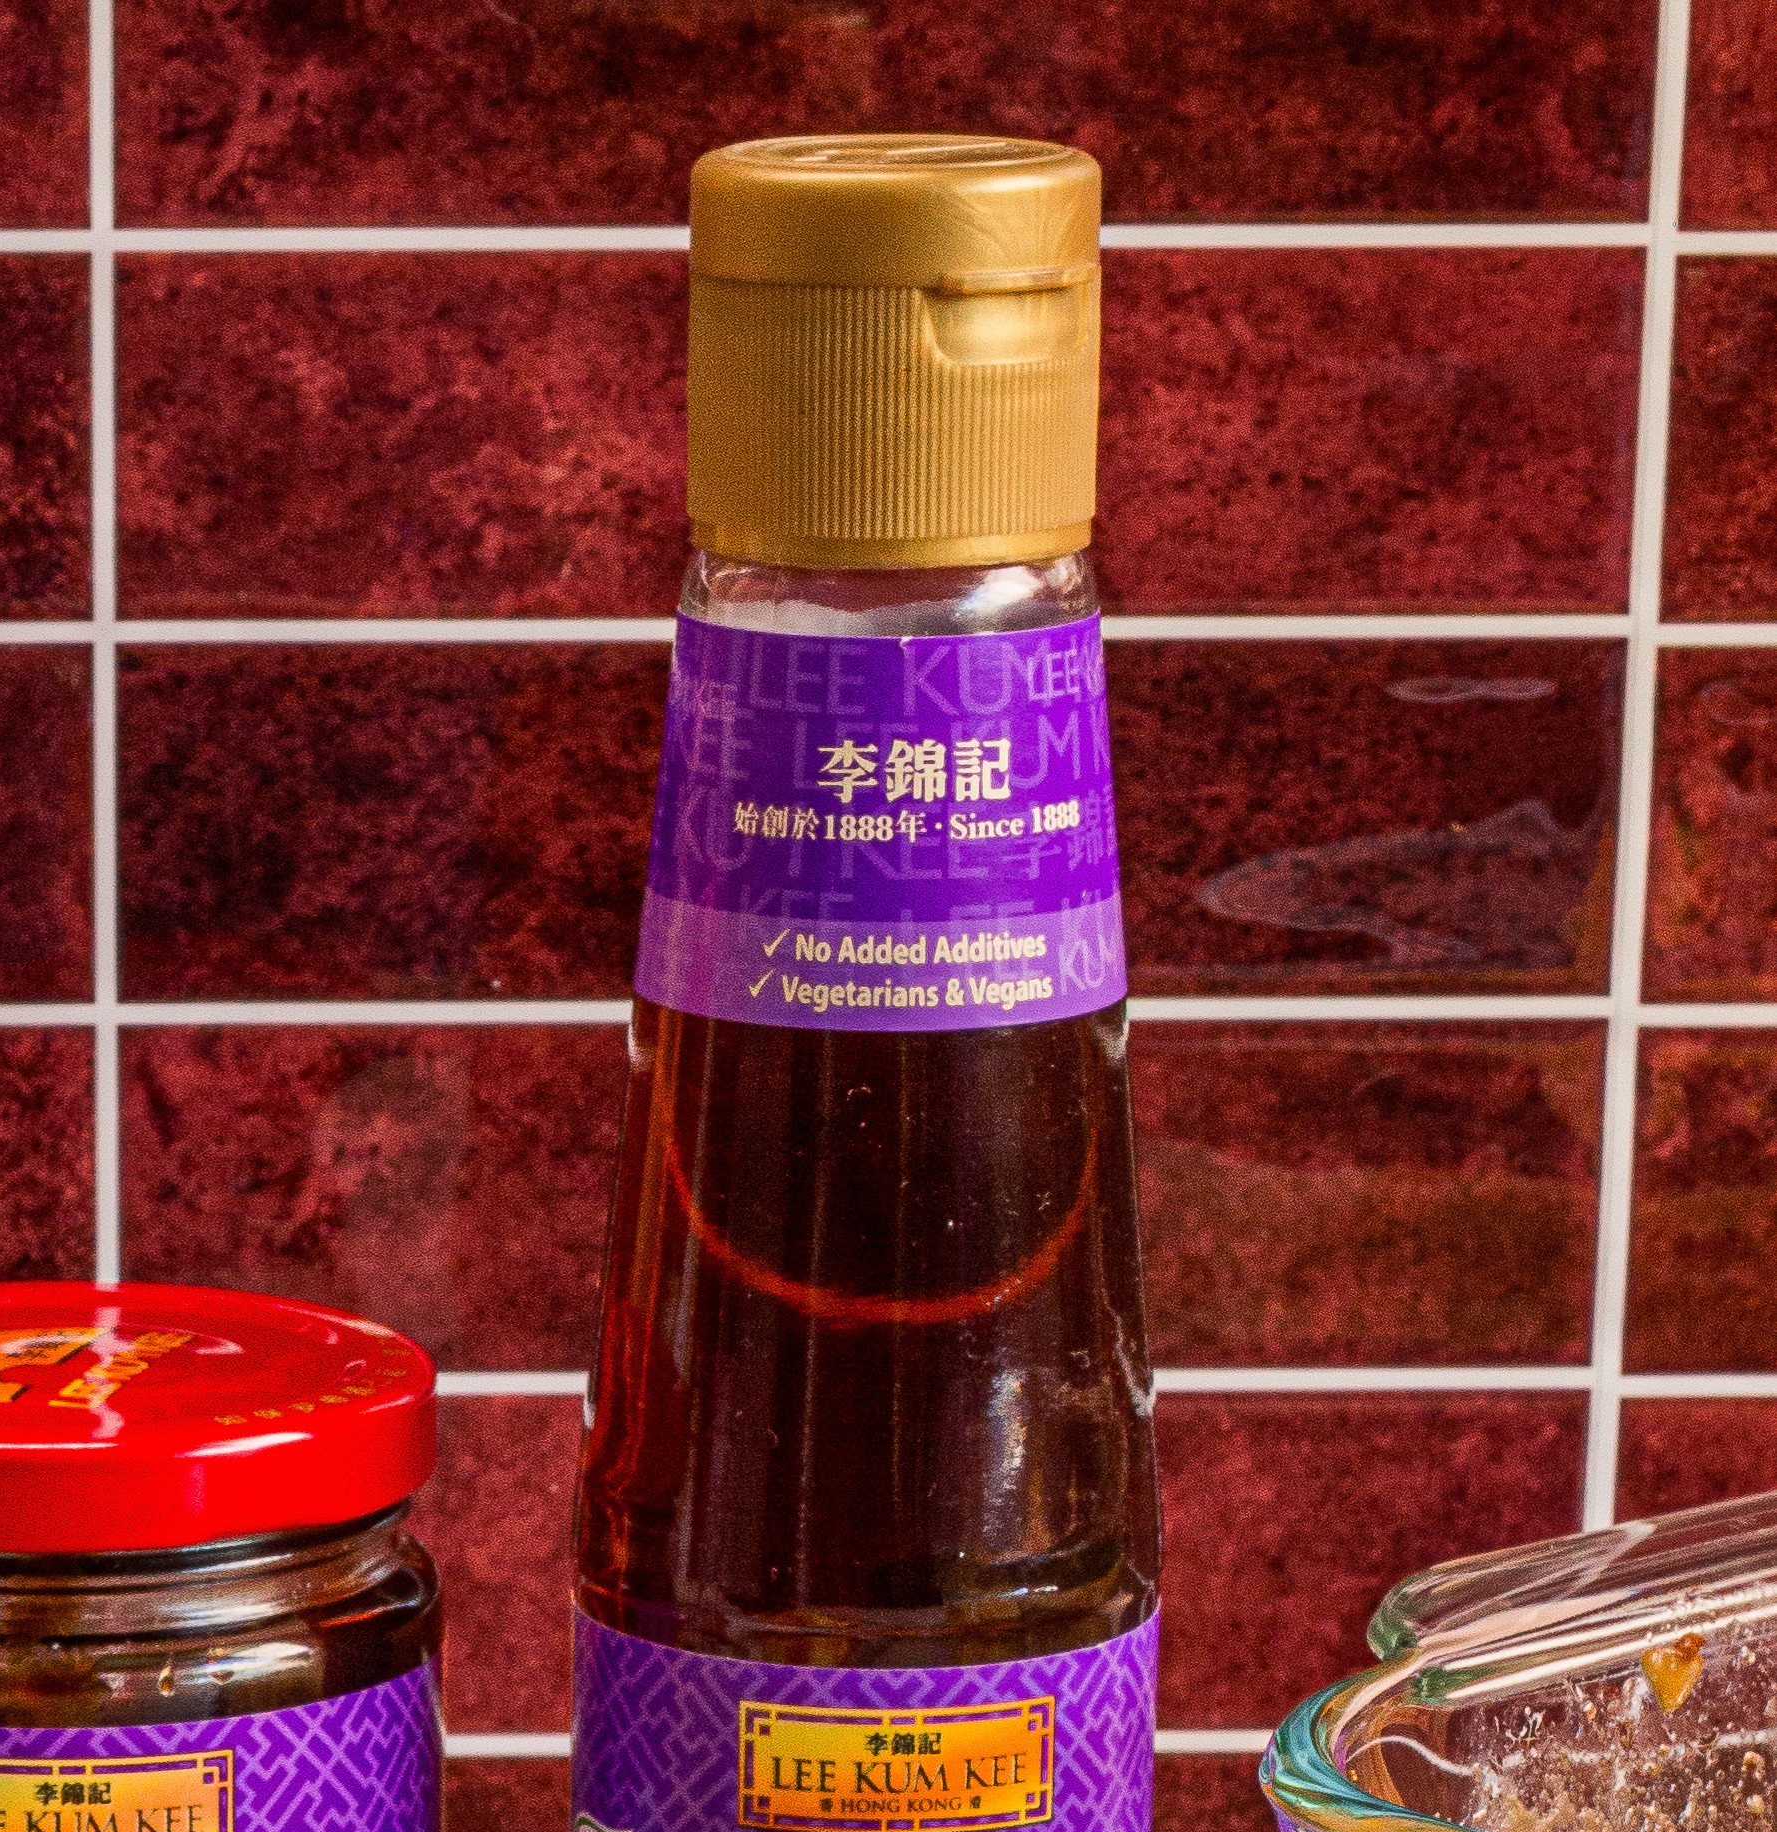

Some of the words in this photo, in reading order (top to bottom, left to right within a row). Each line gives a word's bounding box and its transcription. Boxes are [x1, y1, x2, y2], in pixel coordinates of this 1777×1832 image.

[816, 738, 1011, 804] 李錦記
[948, 810, 1023, 840] Since
[1029, 800, 1080, 835] 1888
[795, 933, 830, 963] No
[838, 933, 927, 965] Added
[934, 930, 1047, 965] Additives
[781, 974, 940, 1013] Vegetarians
[945, 978, 966, 1006] &
[968, 976, 1053, 1012] Vegans
[865, 1732, 942, 1757] 李錦記
[771, 1757, 838, 1792] LEE
[853, 1760, 949, 1795] KUM
[964, 1753, 1027, 1790] KEE
[34, 1781, 111, 1806] 李錦記
[840, 1797, 900, 1814] HONG
[907, 1797, 963, 1813] KONG
